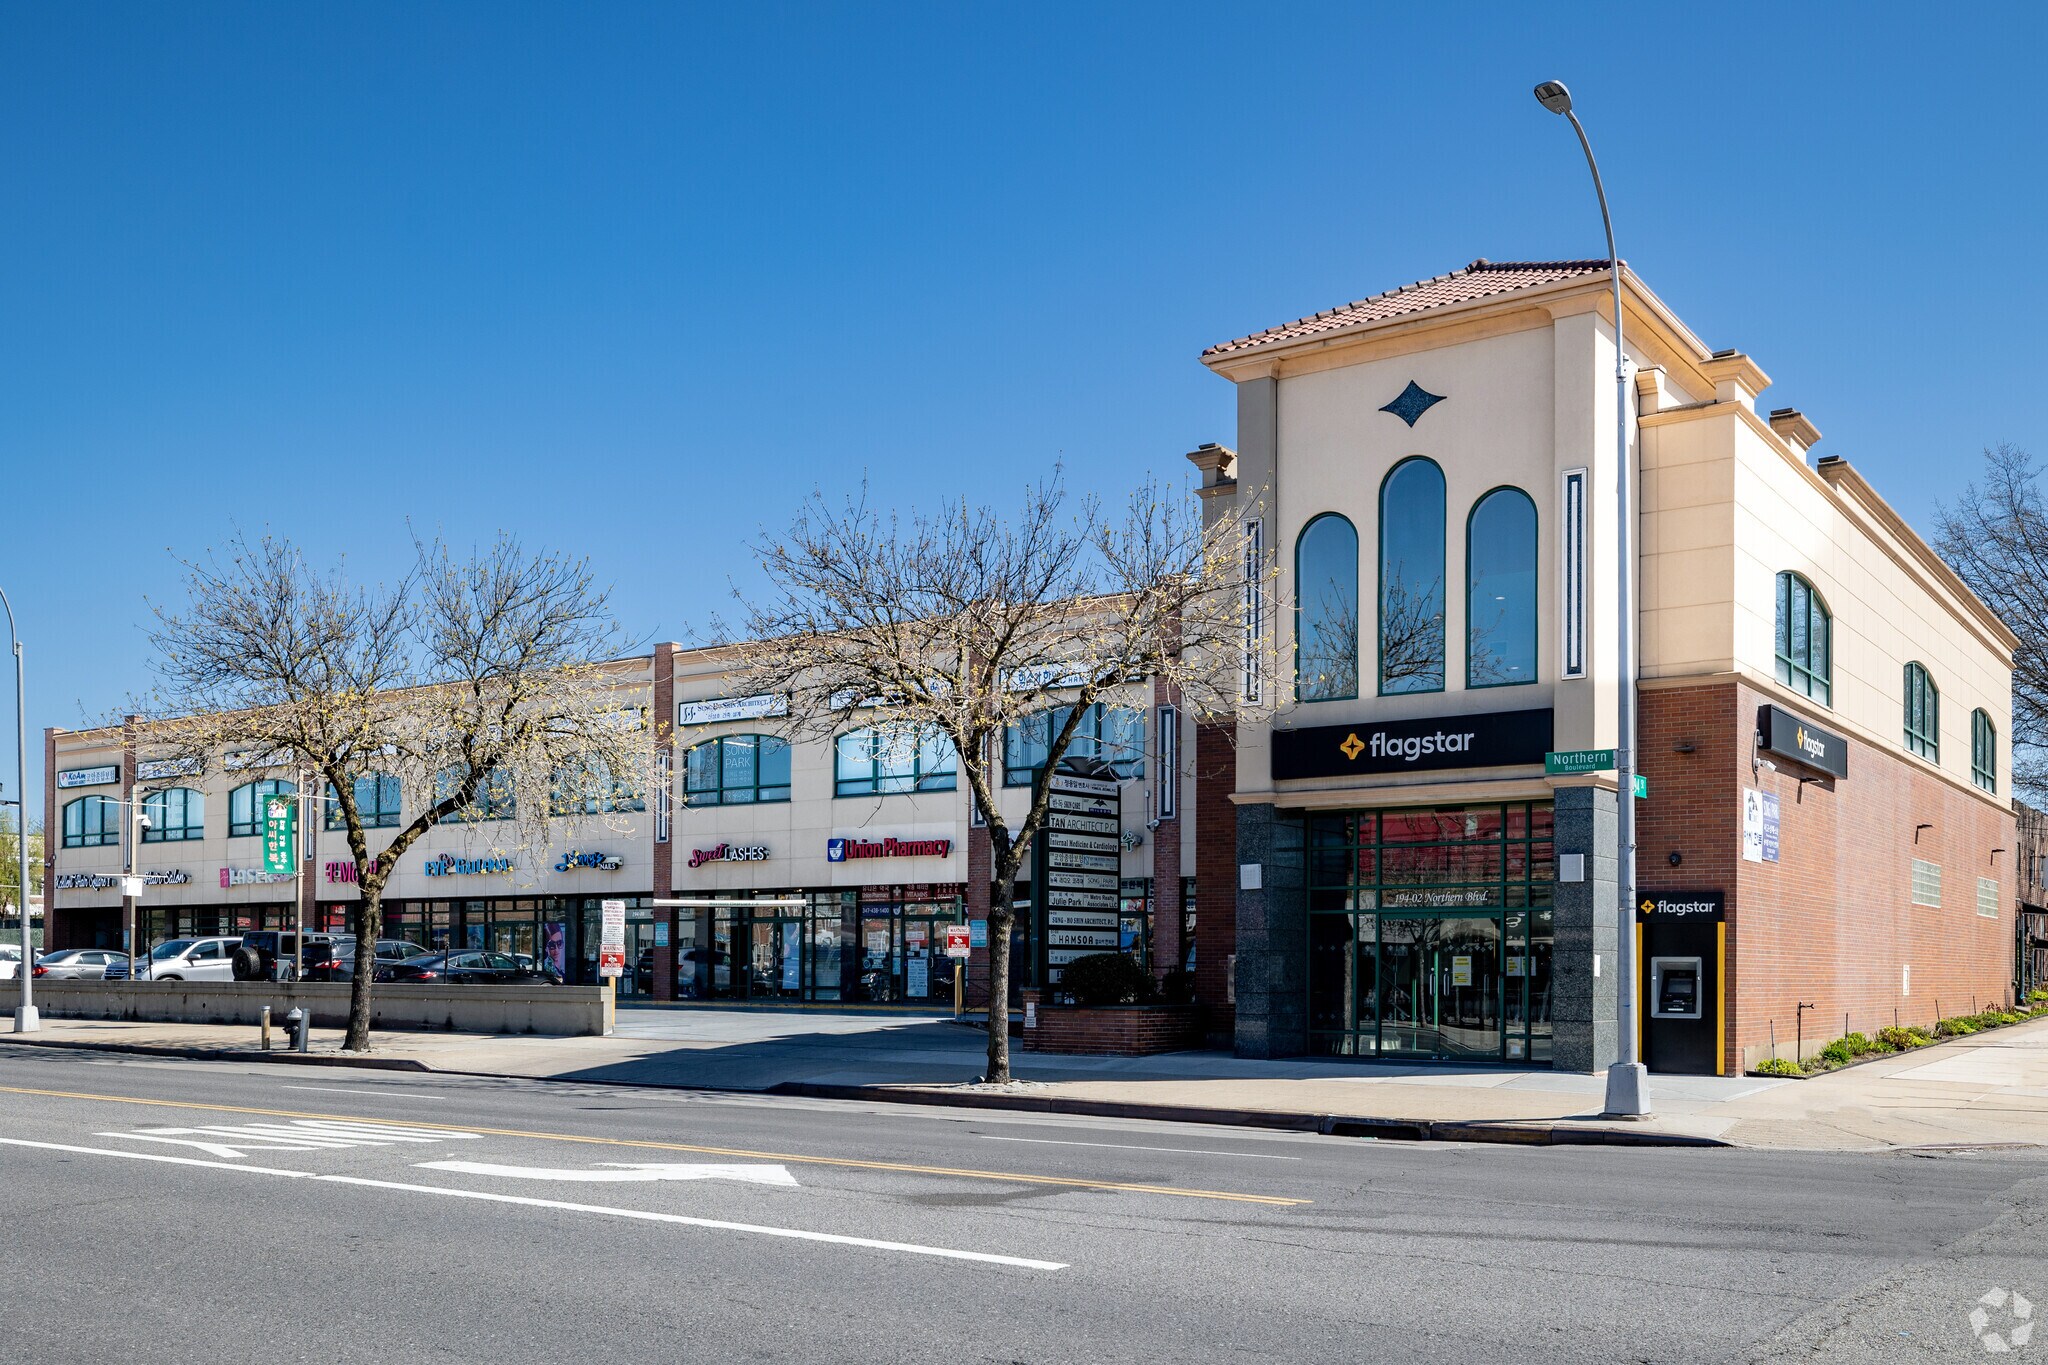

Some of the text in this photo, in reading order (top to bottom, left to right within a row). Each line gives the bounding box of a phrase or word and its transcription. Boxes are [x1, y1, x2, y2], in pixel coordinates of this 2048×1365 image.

[1370, 731, 1475, 761] flagstar
[1804, 730, 1825, 758] flagstar
[725, 745, 752, 757] SONG
[725, 757, 751, 769] PARK
[1553, 752, 1607, 765] Northern
[67, 771, 86, 780] KoAm
[1051, 817, 1066, 828] TAN
[1066, 819, 1104, 832] ARCHITECT
[845, 838, 950, 860] Union Pharmacy
[1049, 839, 1069, 847] Internal
[1069, 840, 1089, 849] Medicine
[1093, 841, 1118, 852] Cardiology
[688, 843, 764, 868] Sweet LASHES
[424, 860, 448, 877] EYE
[600, 863, 616, 871] NAILS
[163, 869, 187, 884] Salon
[1052, 897, 1082, 906] Julie Park
[1394, 890, 1489, 903] 194-02 Northern Blvd.
[1657, 900, 1715, 917] flagstar
[1058, 935, 1094, 945] HAMSOA
